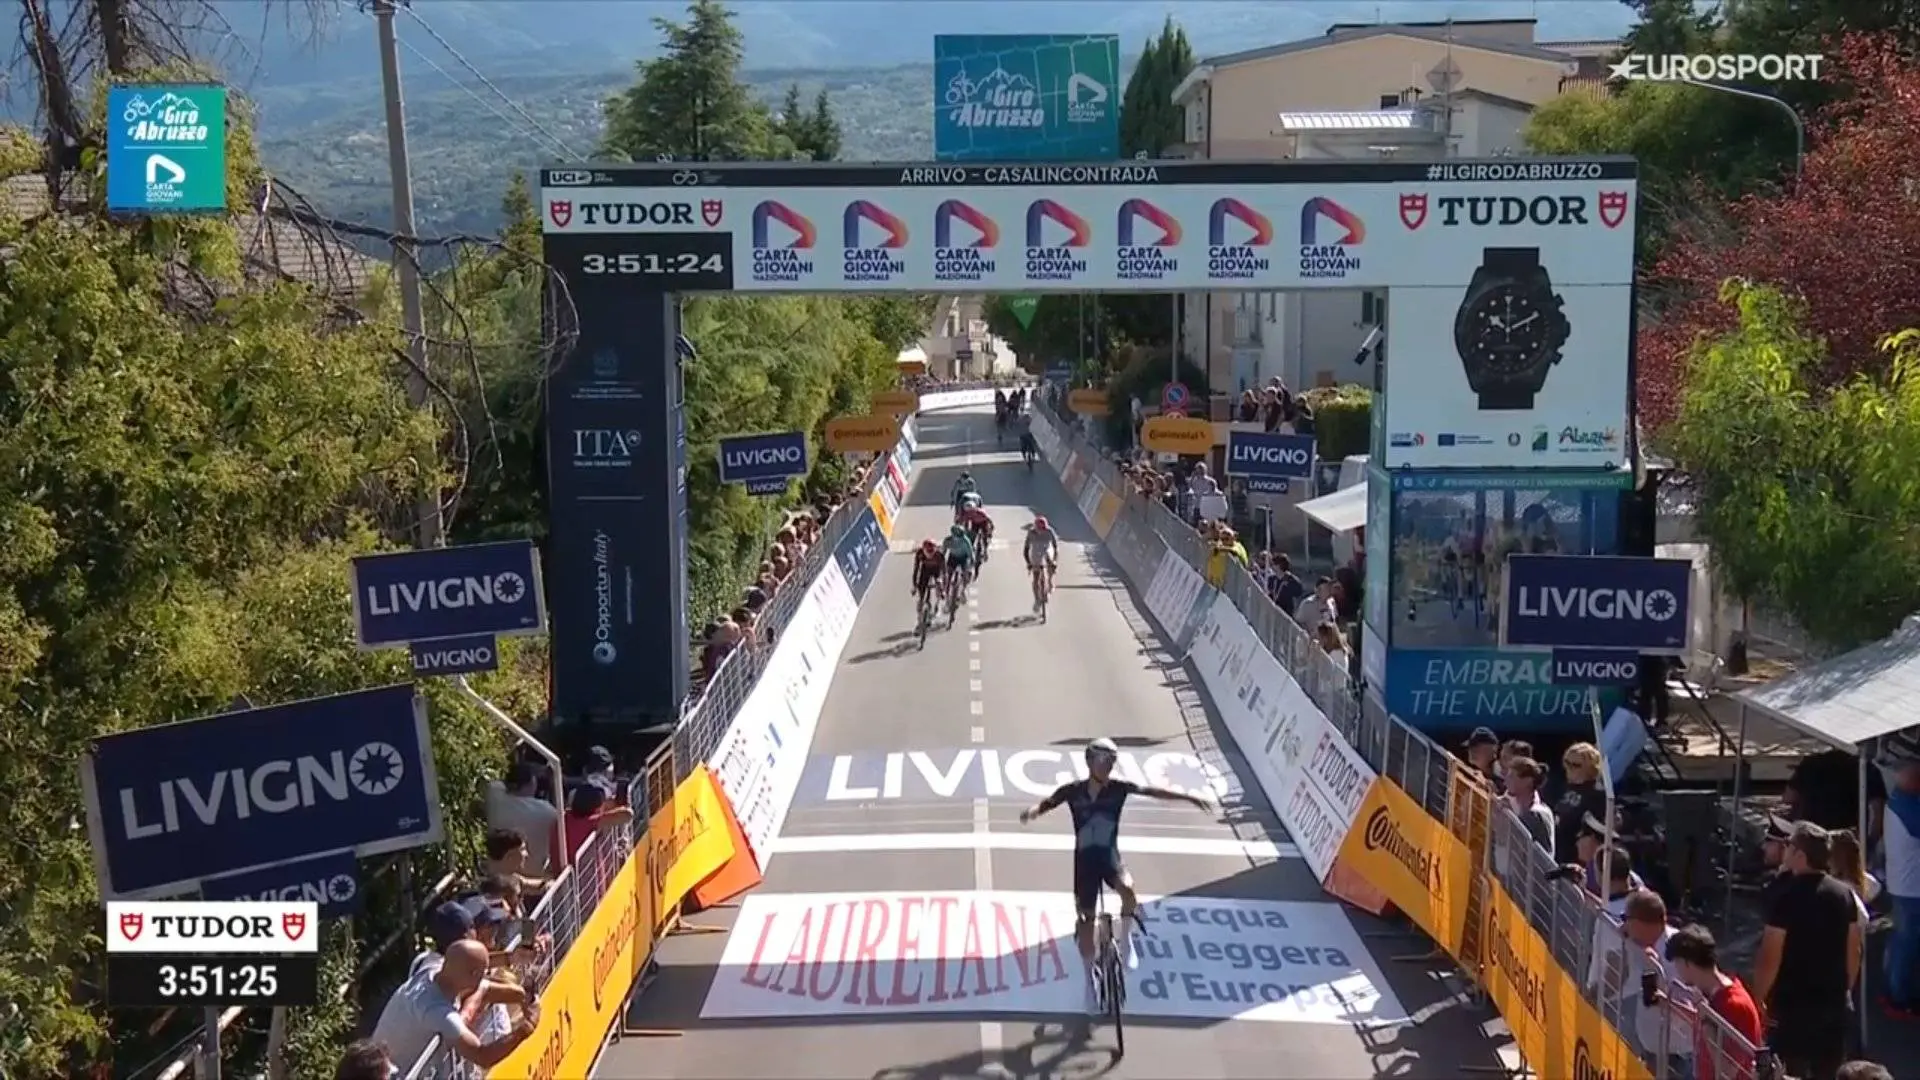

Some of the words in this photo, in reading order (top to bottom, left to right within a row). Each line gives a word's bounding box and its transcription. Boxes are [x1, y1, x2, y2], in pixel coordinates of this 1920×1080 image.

[993, 83, 1034, 107] Giro
[552, 173, 576, 182] UCI
[901, 168, 966, 183] ARRIVO
[985, 167, 1159, 183] CASALINCONTRADA
[1427, 164, 1602, 180] #ILGIRODABRUZZO
[580, 203, 694, 225] TUDOR
[1438, 196, 1588, 226] TUDOR
[753, 250, 797, 261] CARTA
[844, 250, 889, 260] CARTA
[935, 249, 980, 260] CARTA
[1026, 249, 1071, 259] CARTA
[1117, 248, 1162, 259] CARTA
[1209, 247, 1254, 258] CARTA
[1300, 247, 1345, 258] CARTA
[583, 254, 724, 273] 3:51:24
[753, 262, 812, 273] GIOVANI
[844, 262, 904, 273] GIOVANI
[935, 262, 995, 272] GIOVANI
[1026, 261, 1086, 272] GIOVANI
[1117, 260, 1178, 271] GIOVANI
[1209, 259, 1269, 271] GIOVANI
[1300, 259, 1360, 270] GIOVANI
[573, 430, 630, 456] ITA
[726, 446, 801, 467] LIVIGNO
[1233, 445, 1309, 465] LIVIGNO
[1250, 481, 1287, 491] LIVIGNO
[367, 571, 526, 616] LIVIGNO
[1518, 586, 1677, 622] LIVIGNO
[412, 647, 492, 670] LIVIGNO
[1556, 661, 1637, 679] LIVIGNO
[1411, 690, 1467, 715] THE
[1318, 742, 1360, 806] TUDOR
[119, 742, 405, 840] LIVIGNO
[1294, 790, 1333, 858] TUDOR
[1364, 804, 1433, 890] Continental
[740, 896, 1069, 1006] LAURETANA
[1183, 934, 1352, 970] leggera
